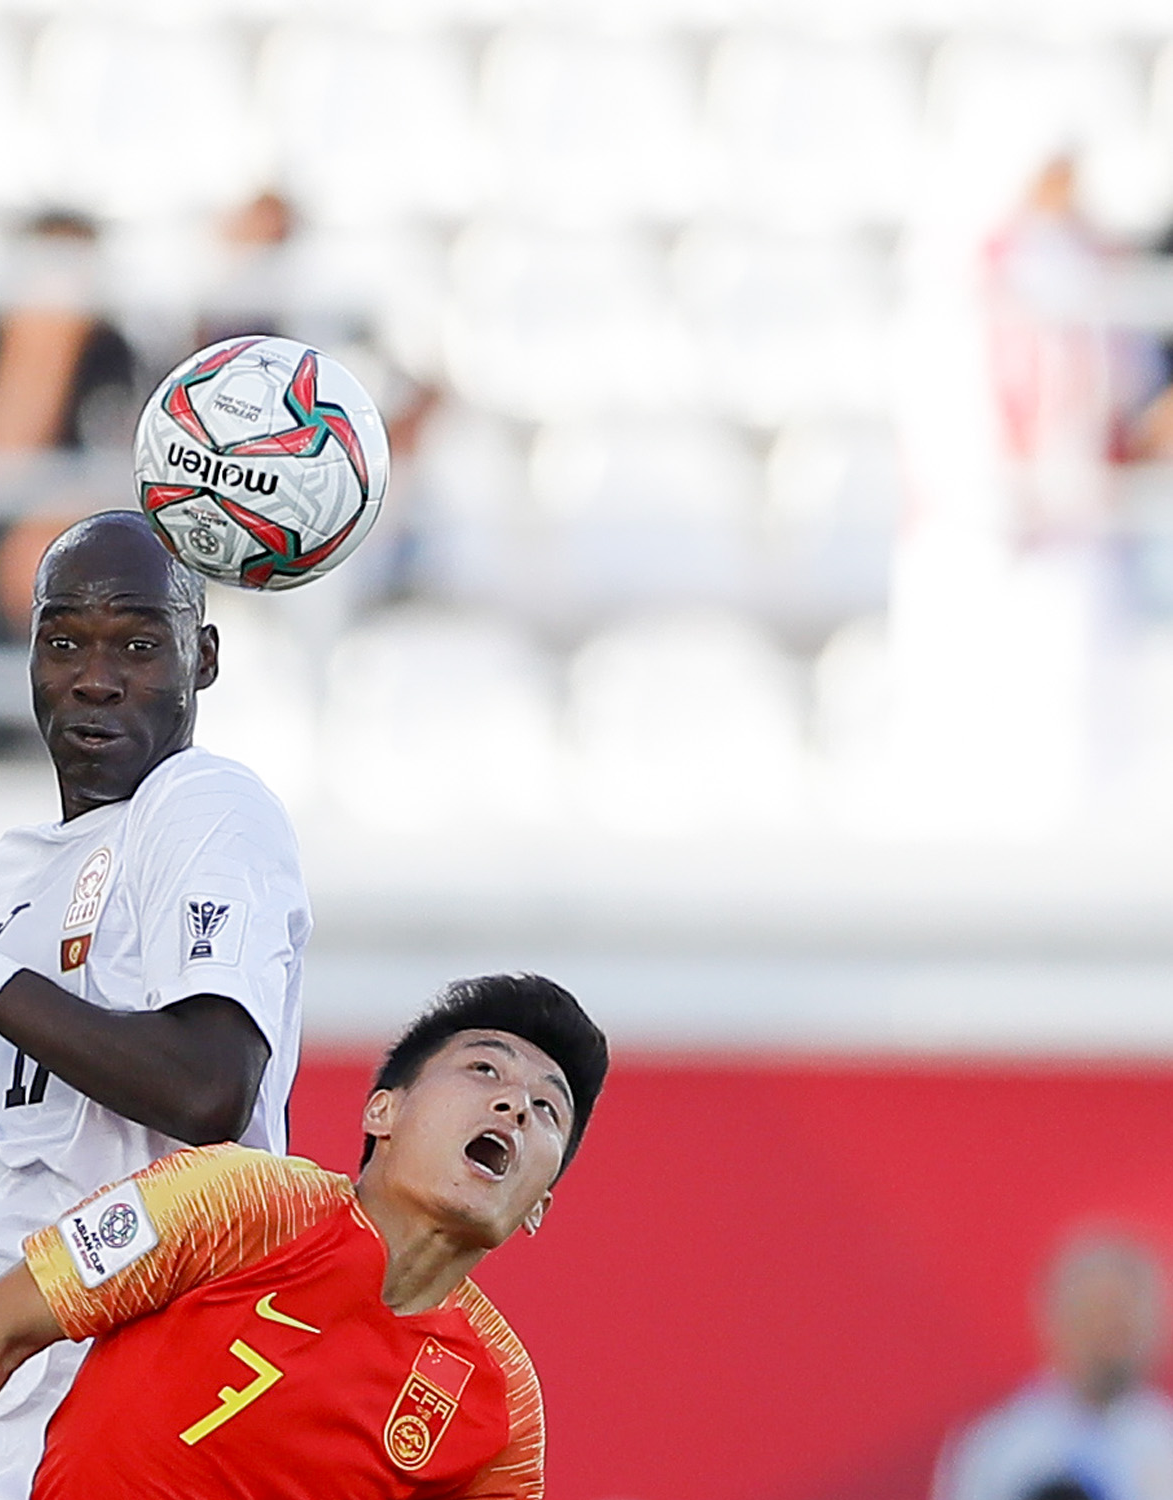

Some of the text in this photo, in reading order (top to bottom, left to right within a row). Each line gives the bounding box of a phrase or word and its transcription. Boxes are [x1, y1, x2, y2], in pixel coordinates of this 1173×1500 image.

[168, 442, 279, 495] molten
[73, 1217, 105, 1275] ASIAN CUP
[178, 1338, 285, 1446] 7
[407, 1381, 451, 1421] CFA
